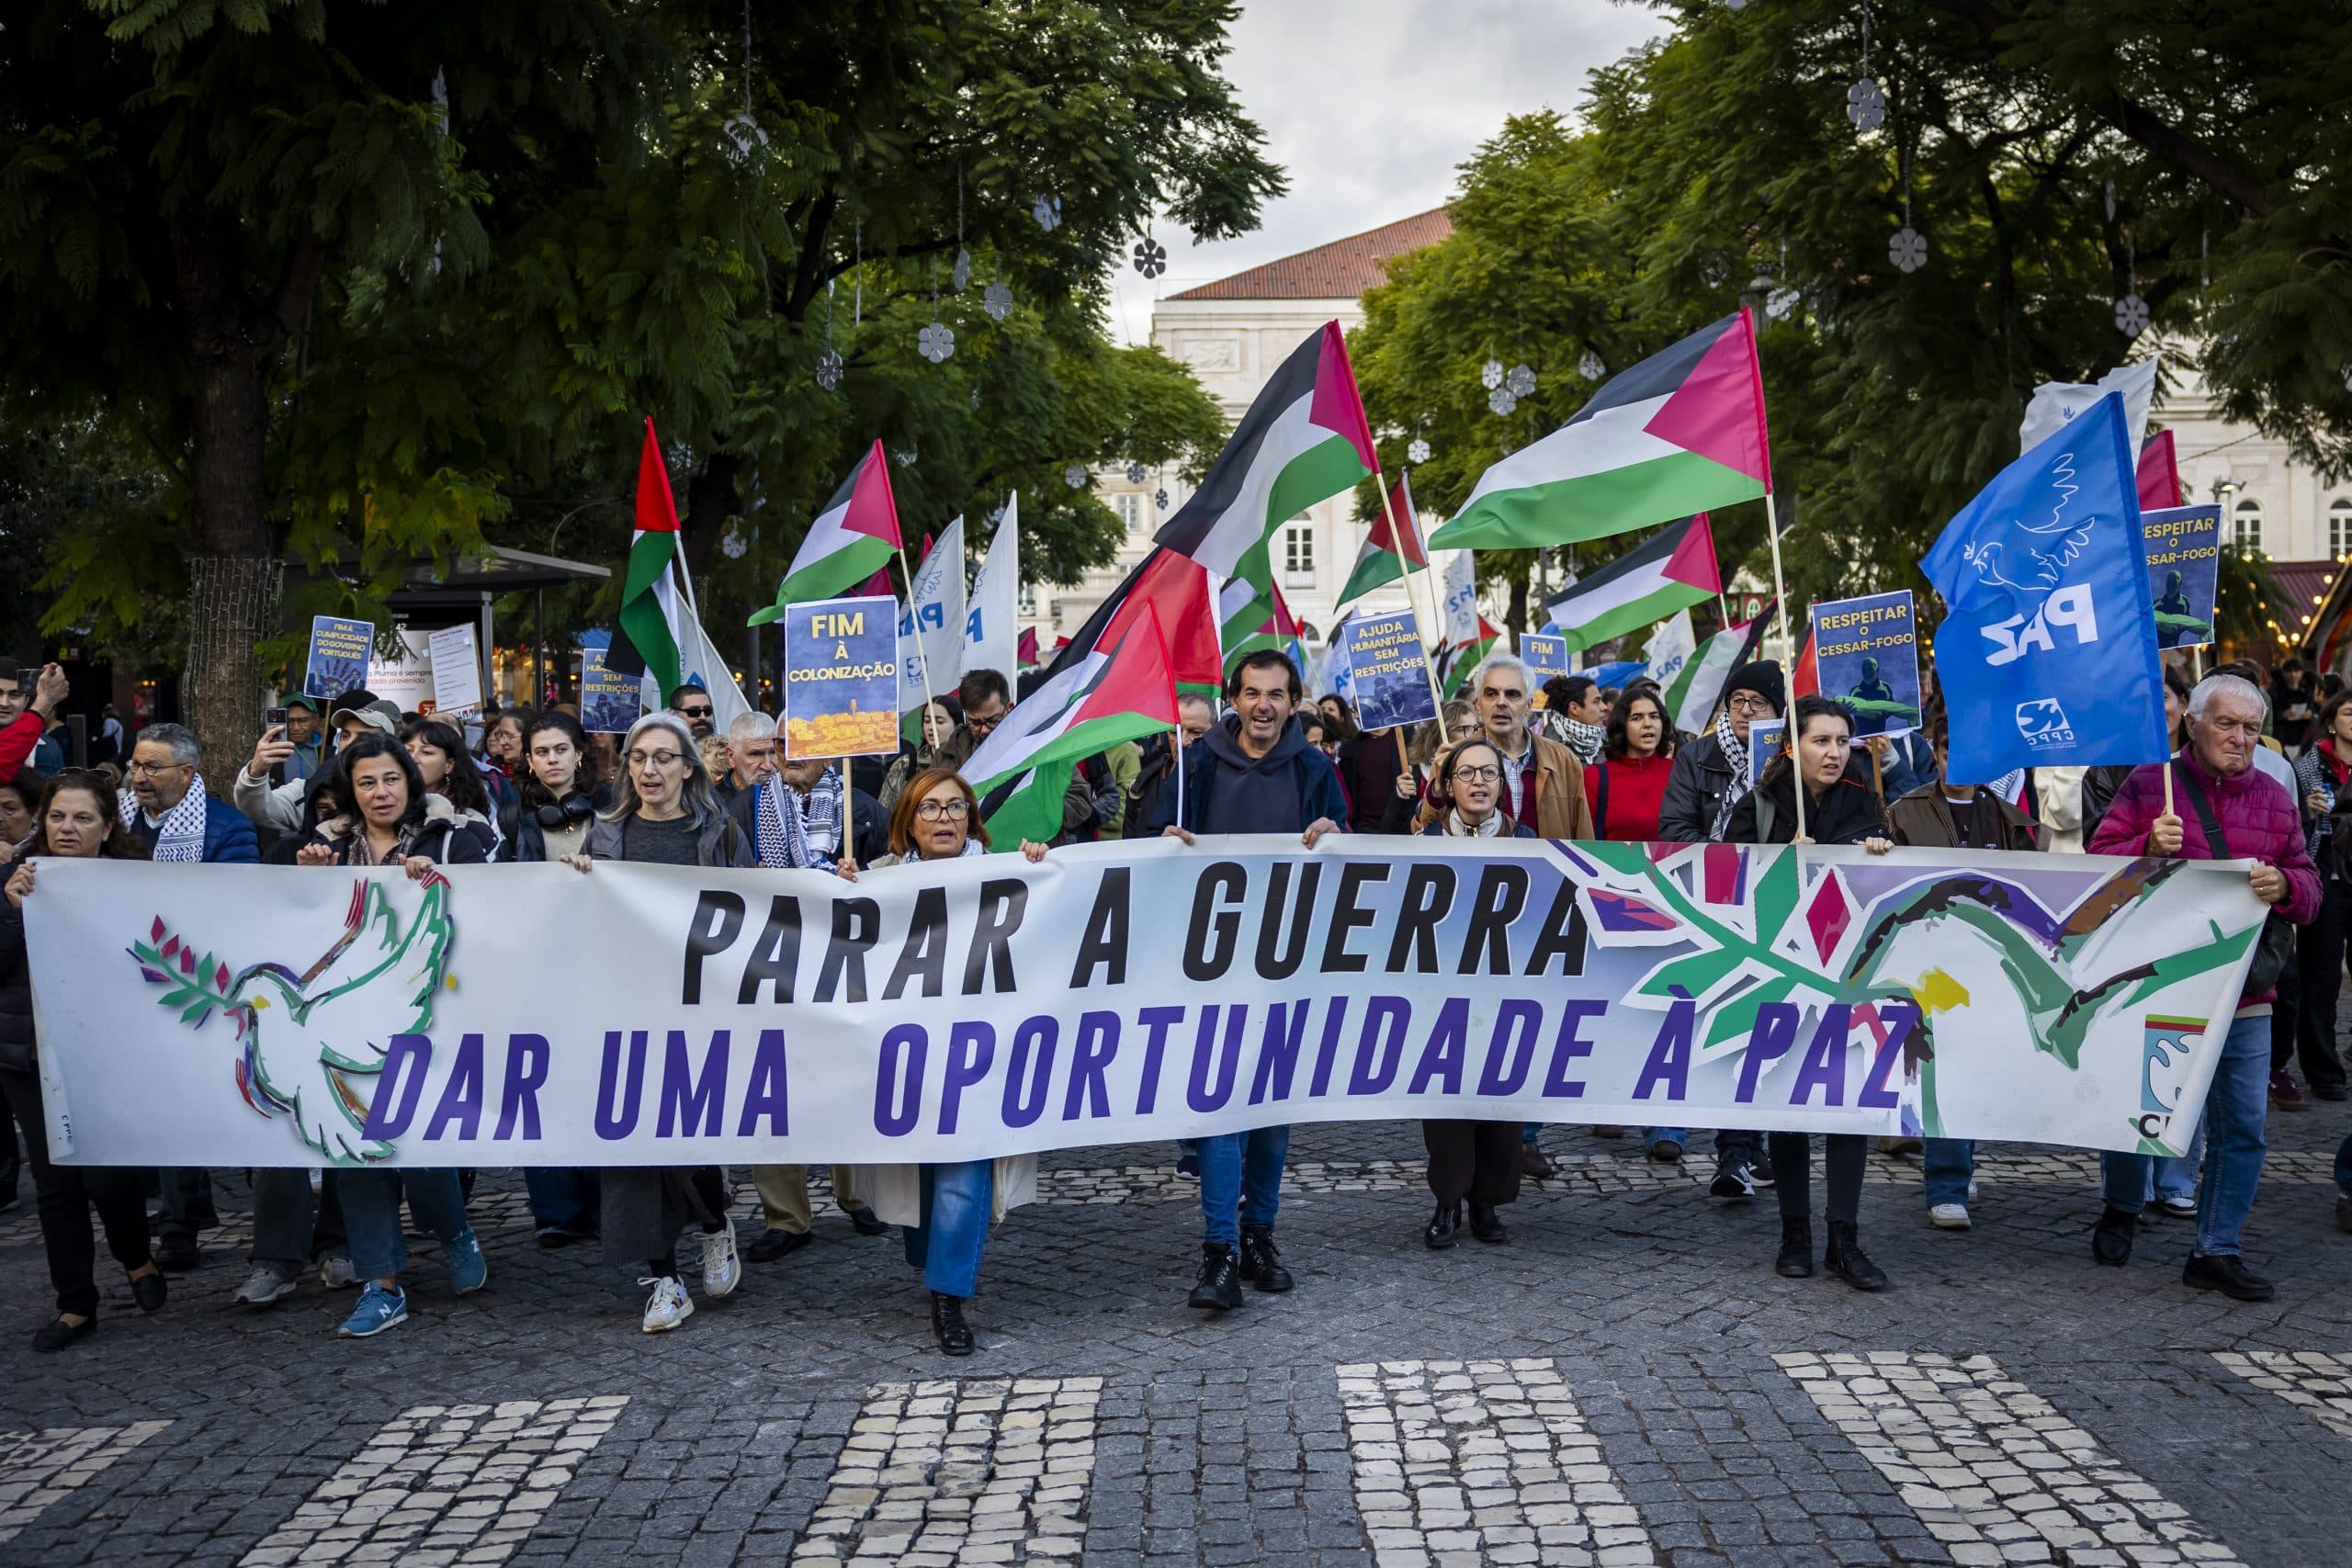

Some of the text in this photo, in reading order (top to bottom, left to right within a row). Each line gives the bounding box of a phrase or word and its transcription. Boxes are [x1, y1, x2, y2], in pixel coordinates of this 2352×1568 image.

[2142, 517, 2215, 539] ESPEITAR
[2169, 537, 2178, 547] O
[2146, 547, 2217, 566] SSAR-FOGO
[811, 612, 864, 638] FIM
[1820, 604, 1907, 630] RESPEITAR
[315, 630, 369, 642] CUMPLICIDADE
[1359, 621, 1404, 638] AJUDA
[1860, 626, 1869, 636] O
[329, 640, 366, 651] GOVERNO
[834, 640, 849, 660] À
[1351, 632, 1419, 653] HUMANITÁRIA
[1531, 641, 1554, 655] FIM
[1818, 633, 1913, 657] CESSAR-FOGO
[318, 648, 363, 660] PORTUGUÊS
[1374, 648, 1399, 660] SEM
[603, 674, 622, 682] SEM
[788, 660, 896, 683] COLONIZAÇÃO
[1354, 658, 1425, 679] RESTRIÇÕES
[585, 683, 639, 694] RESTRIÇÕES
[683, 861, 1588, 1005] PARAR A GUERRA
[360, 984, 1921, 1142] DAR UMA OPORTUNIDADE À PAZ
